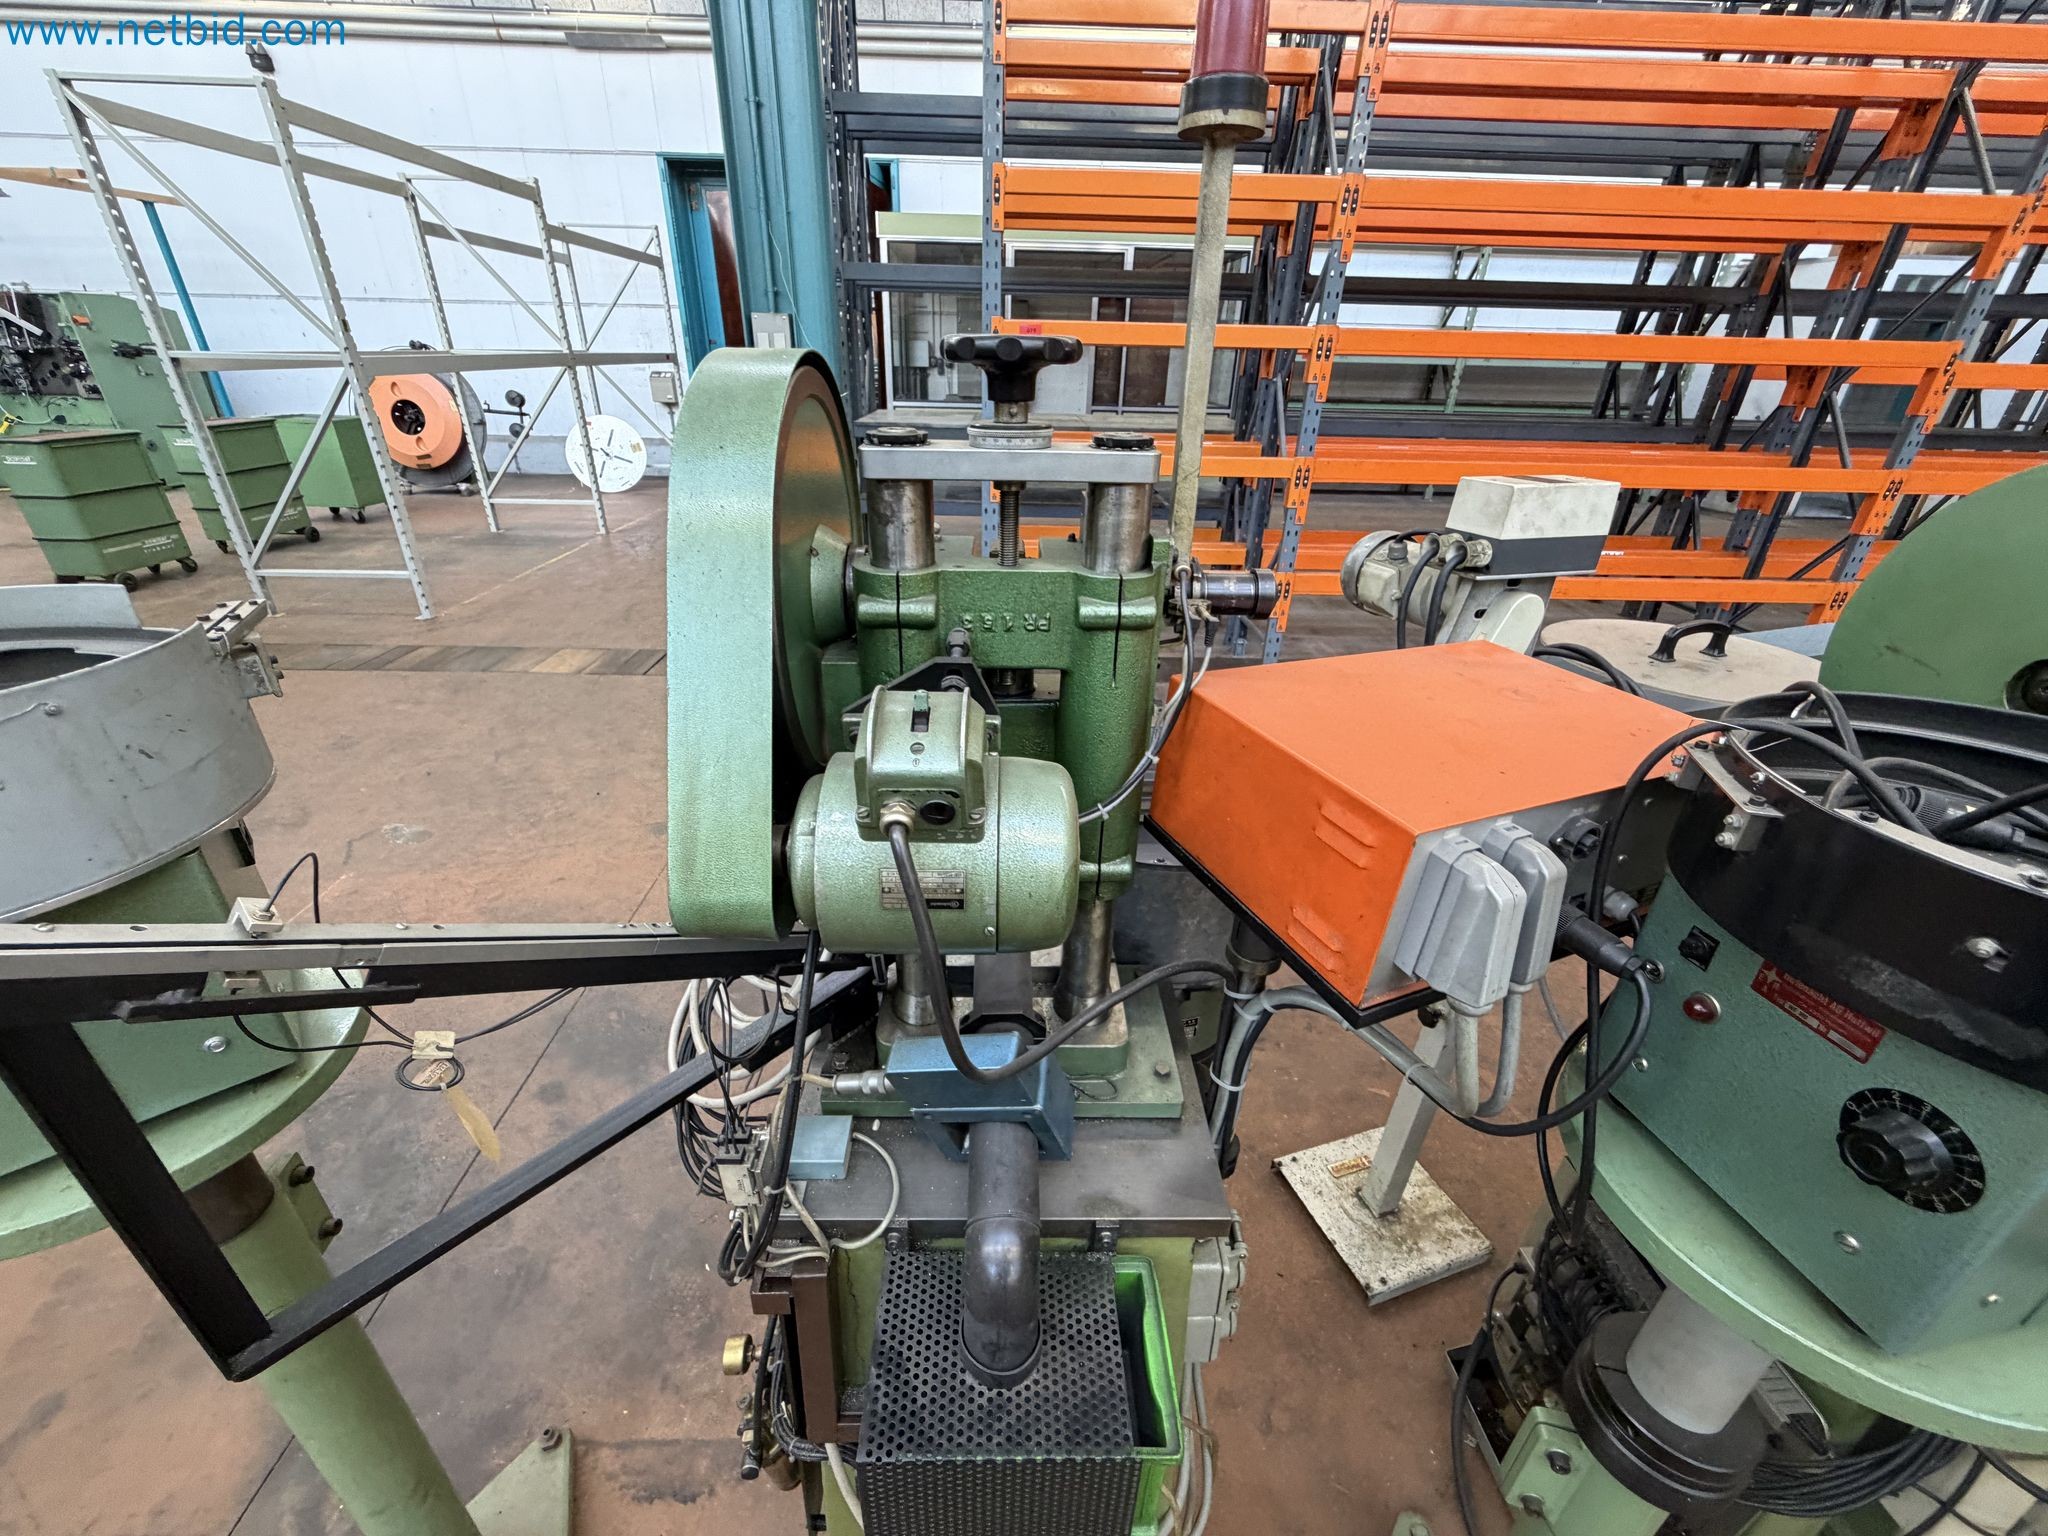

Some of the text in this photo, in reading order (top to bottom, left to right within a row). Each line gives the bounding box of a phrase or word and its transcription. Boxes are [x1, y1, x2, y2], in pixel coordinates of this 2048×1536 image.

[1023, 612, 1051, 633] PR
[1890, 1089, 1901, 1100] 2
[1921, 1101, 1932, 1112] 3
